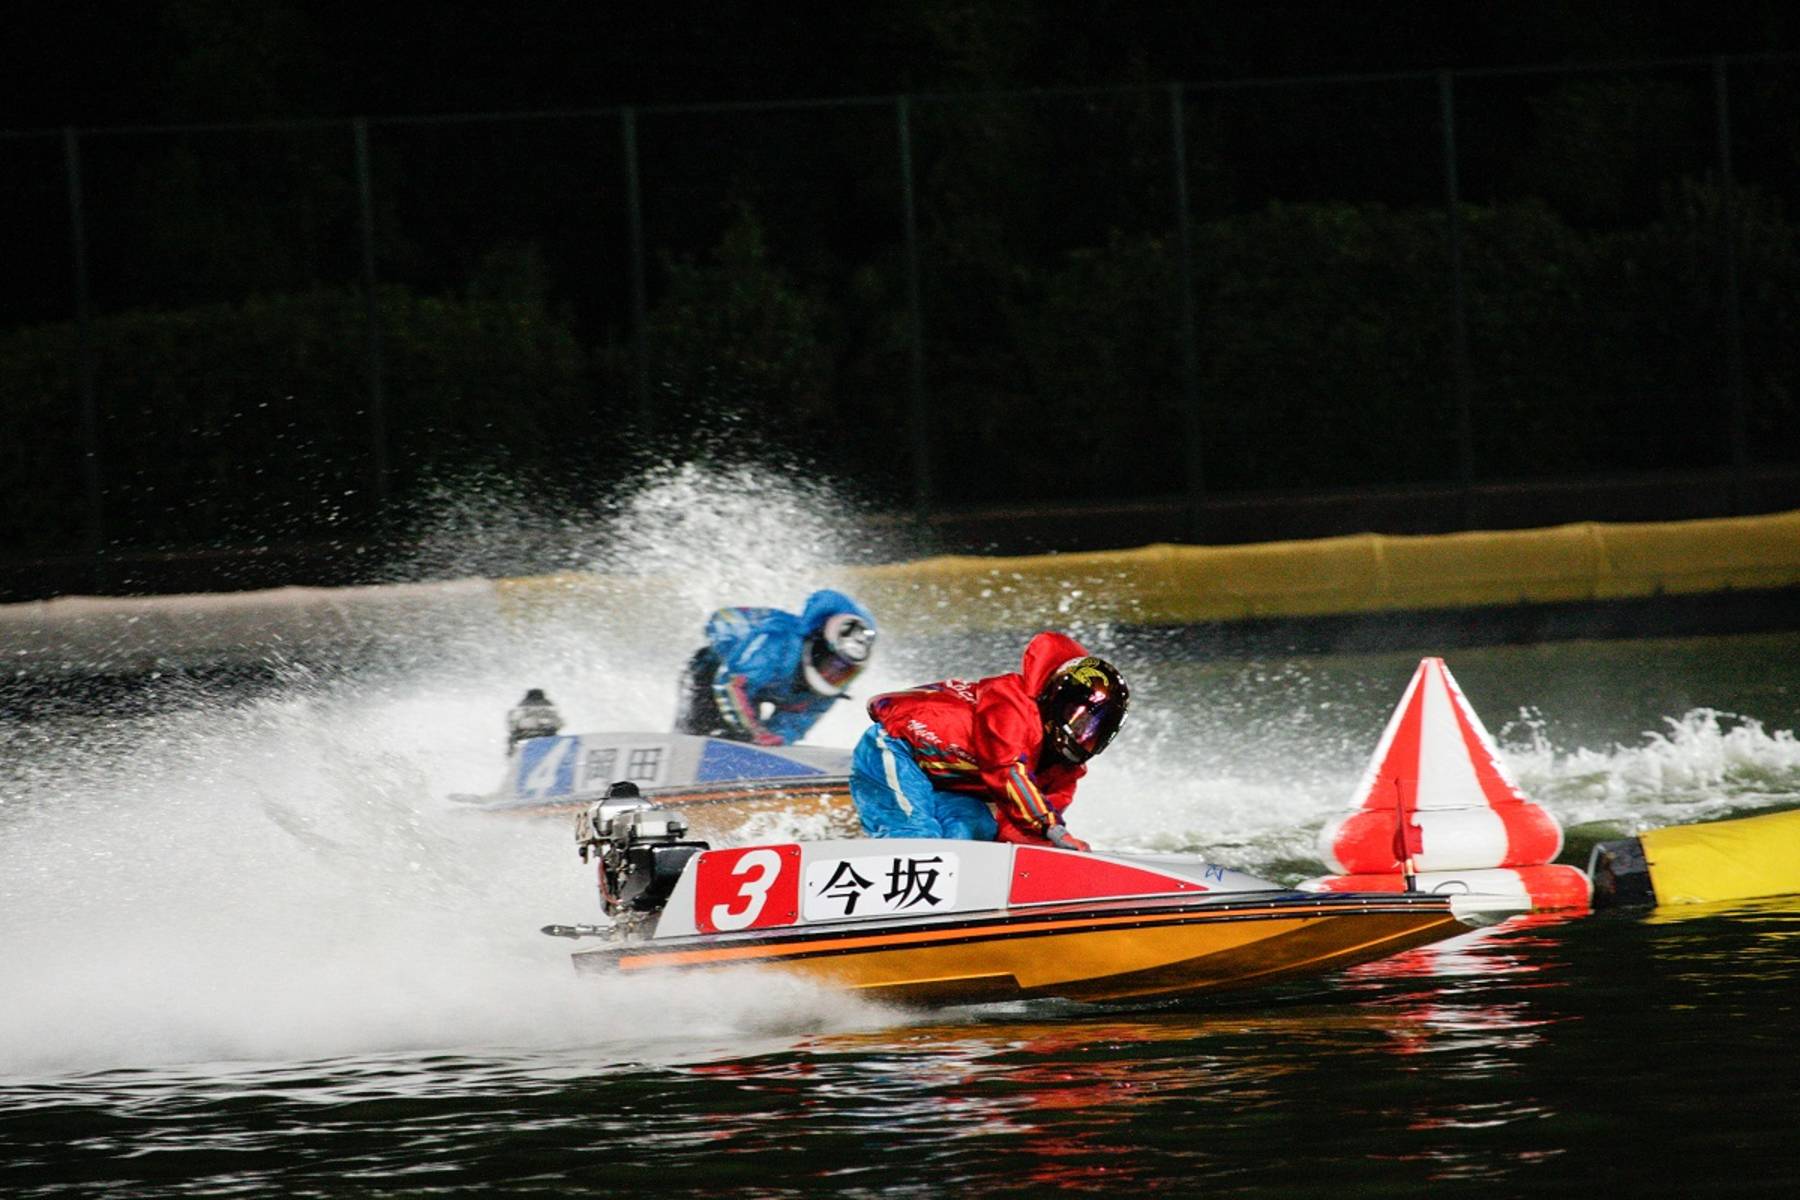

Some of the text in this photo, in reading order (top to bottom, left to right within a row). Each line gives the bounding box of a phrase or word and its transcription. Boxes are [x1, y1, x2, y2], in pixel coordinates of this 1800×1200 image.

[524, 737, 574, 798] 4
[711, 848, 782, 931] 3
[816, 856, 944, 915] 今坂
